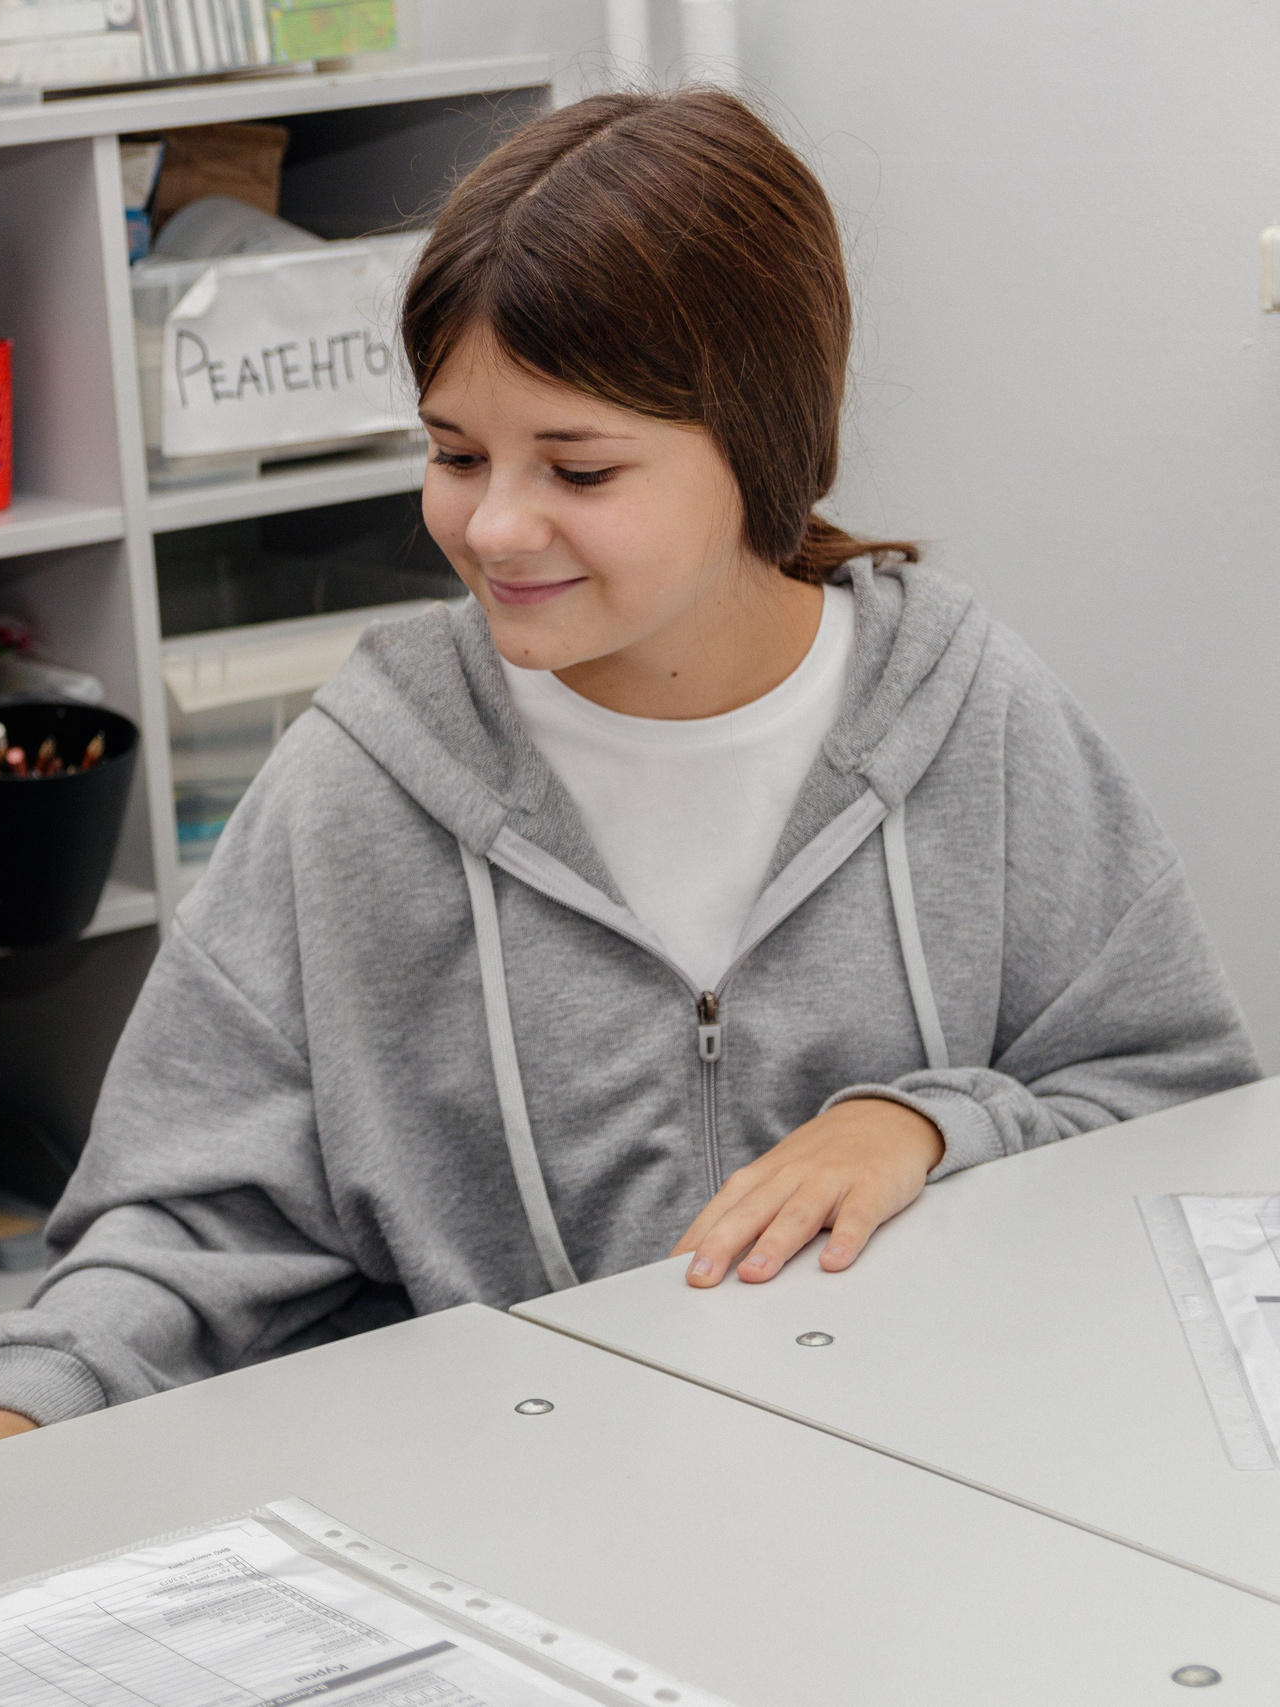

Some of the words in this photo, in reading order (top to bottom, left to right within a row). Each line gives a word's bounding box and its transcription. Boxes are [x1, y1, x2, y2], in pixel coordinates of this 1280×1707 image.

[166, 1551, 213, 1570] консультанта
[211, 1546, 232, 1556] ФИО
[294, 1662, 348, 1683] Курсы
